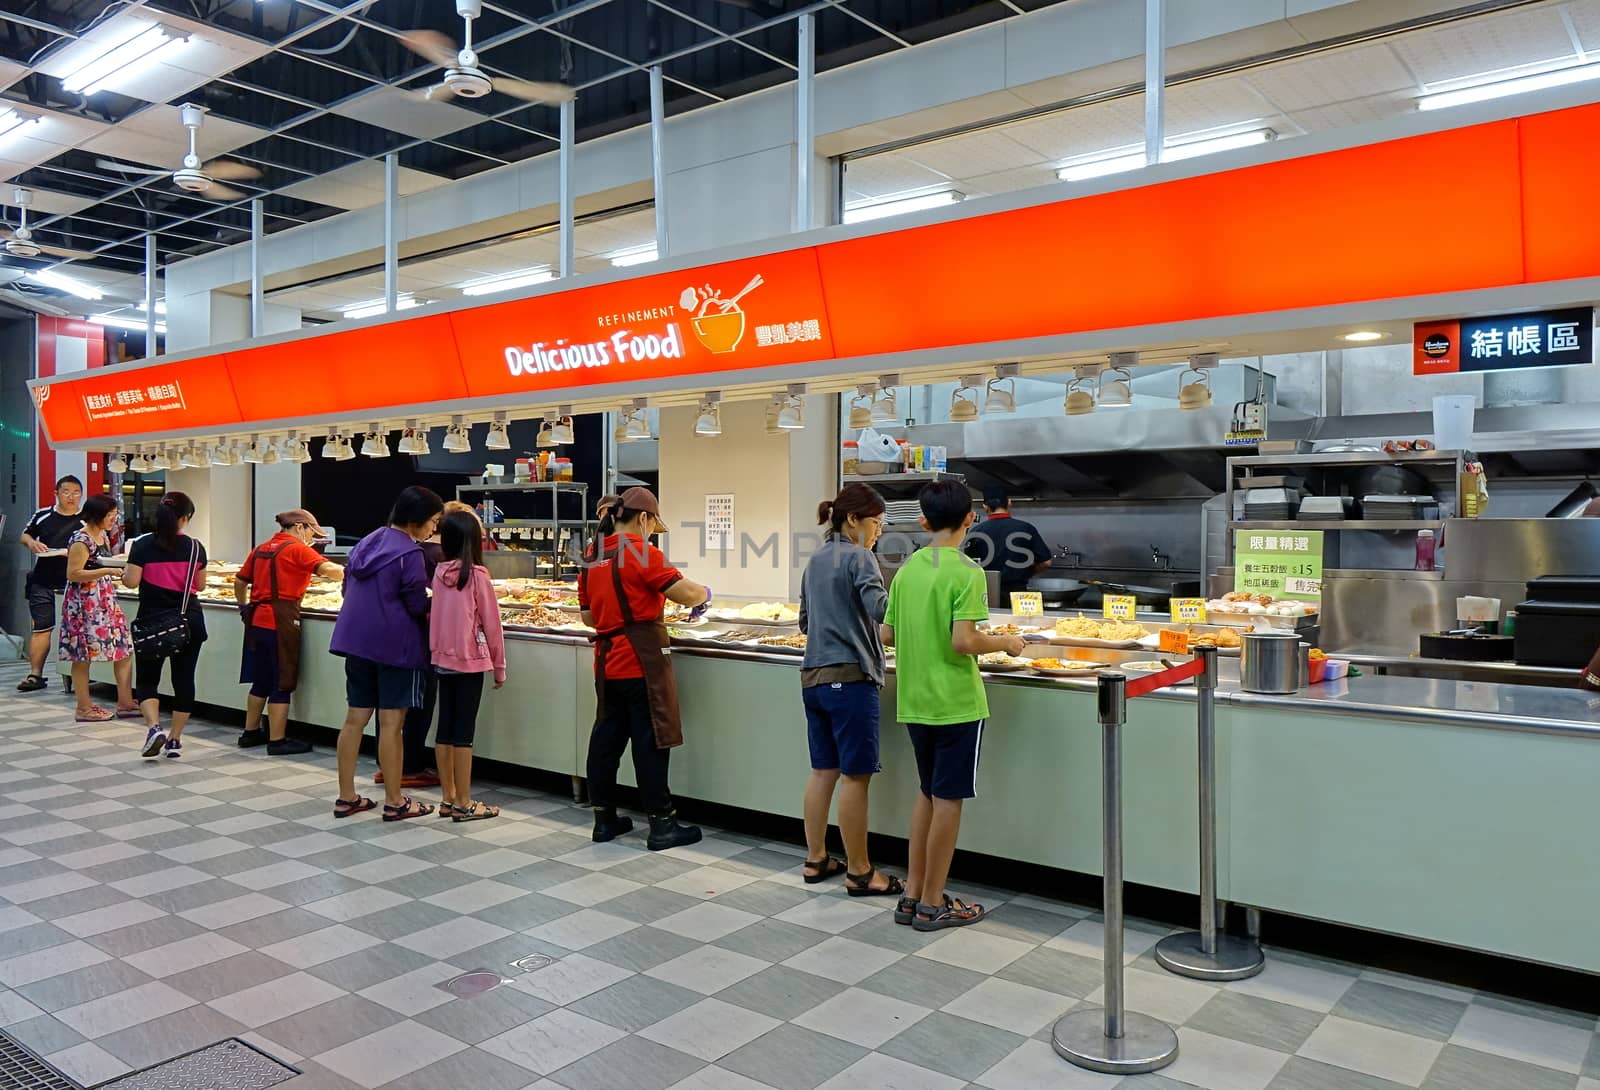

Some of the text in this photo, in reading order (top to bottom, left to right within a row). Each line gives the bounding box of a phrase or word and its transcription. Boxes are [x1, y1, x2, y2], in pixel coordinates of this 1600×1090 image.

[597, 305, 676, 328] REFINEMENT
[504, 322, 684, 377] Delicious Food
[1471, 321, 1580, 359] 結帳區
[1249, 535, 1309, 551] 限量精選
